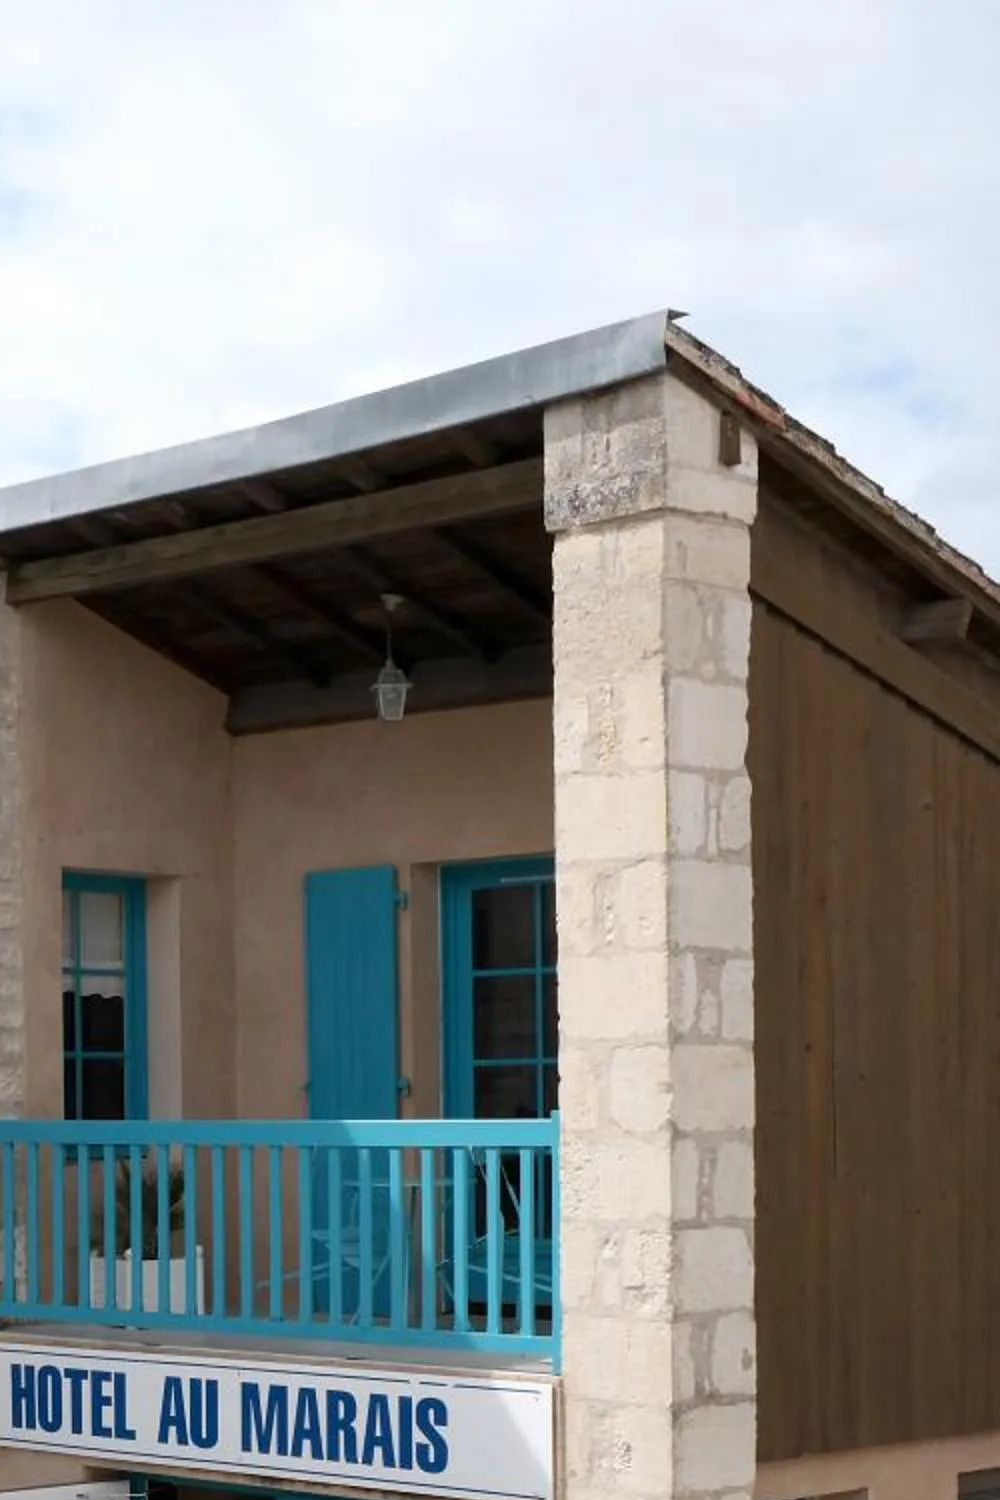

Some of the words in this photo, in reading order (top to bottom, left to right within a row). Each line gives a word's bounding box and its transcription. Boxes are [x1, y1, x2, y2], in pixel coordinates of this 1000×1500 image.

[10, 1365, 136, 1440] HOTEL
[158, 1375, 219, 1449] AU
[241, 1381, 449, 1474] MARAIS
